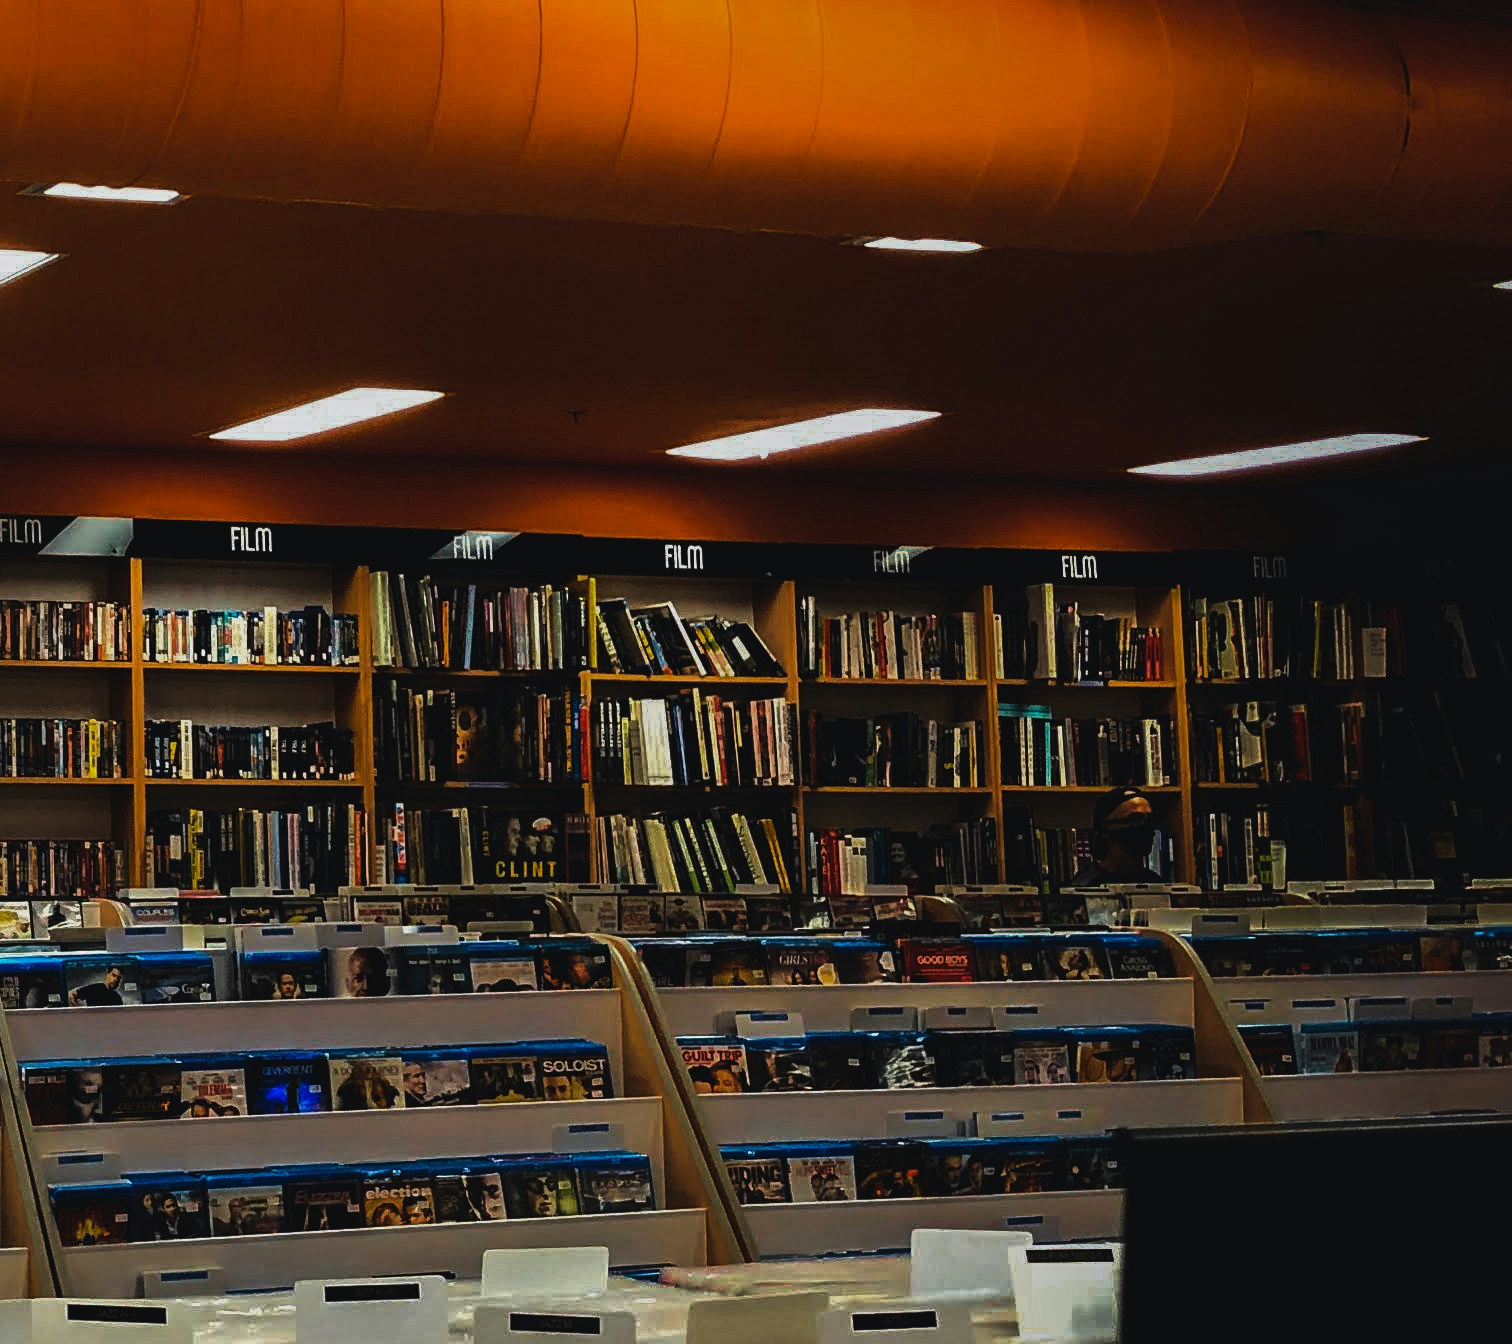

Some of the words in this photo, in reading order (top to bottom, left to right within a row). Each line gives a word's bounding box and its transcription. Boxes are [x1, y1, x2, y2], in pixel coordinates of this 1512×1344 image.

[229, 525, 274, 553] FILM
[452, 534, 494, 561] FILM
[663, 542, 704, 571] FILM
[872, 547, 911, 575] FILM
[1060, 553, 1099, 580] FILM
[1252, 555, 1288, 580] FILM
[495, 860, 557, 878] CLINT
[779, 954, 808, 965] GIRLS
[917, 955, 943, 965] GOOD
[945, 954, 968, 965] BOYS
[542, 1058, 605, 1073] SOLOIST
[682, 1050, 715, 1063] GUILT
[717, 1050, 743, 1062] TRIP
[262, 1064, 315, 1076] DIVERGENT
[365, 1184, 432, 1200] election
